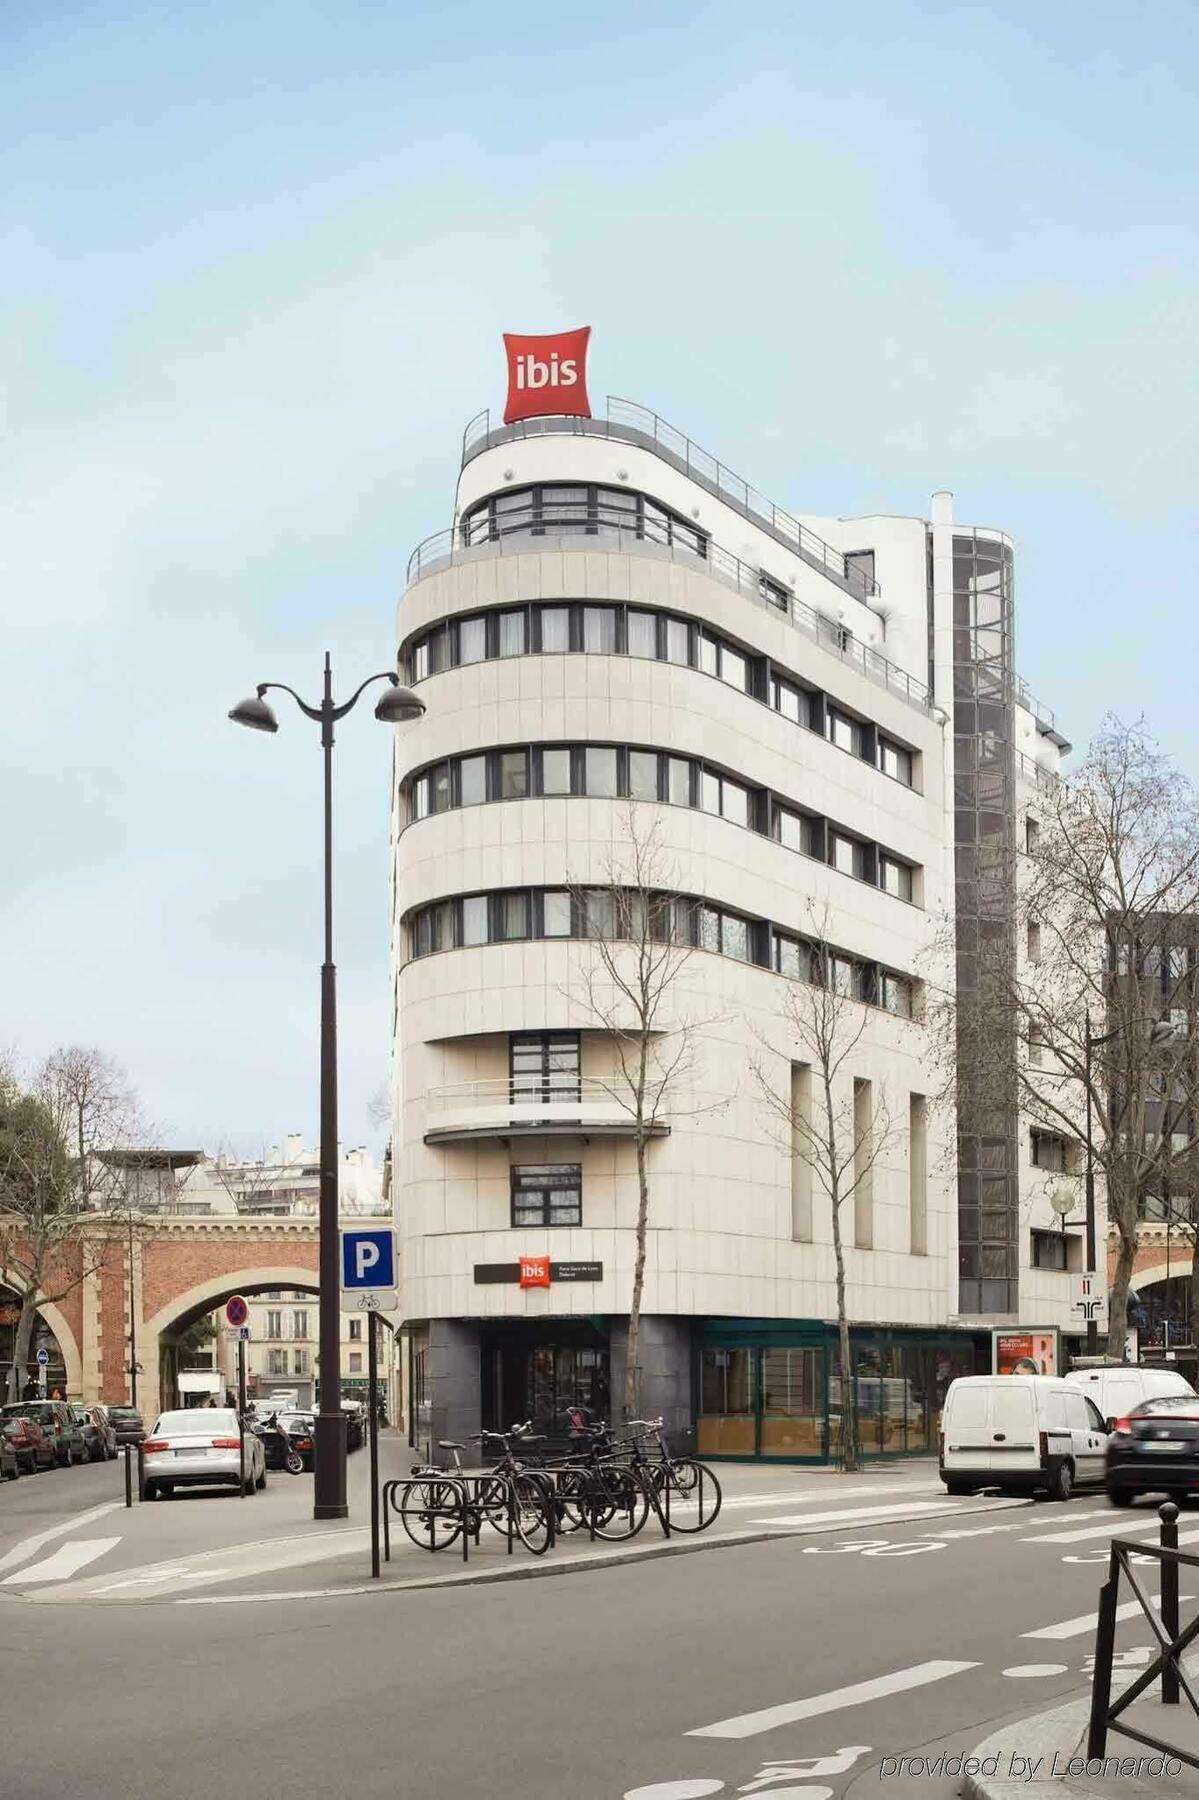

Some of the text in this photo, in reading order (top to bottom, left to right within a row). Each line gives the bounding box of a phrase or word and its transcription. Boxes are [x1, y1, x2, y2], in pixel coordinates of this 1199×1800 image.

[516, 351, 578, 390] ibis
[355, 1241, 380, 1279] P
[522, 1264, 545, 1277] ibis
[802, 1540, 948, 1556] 30
